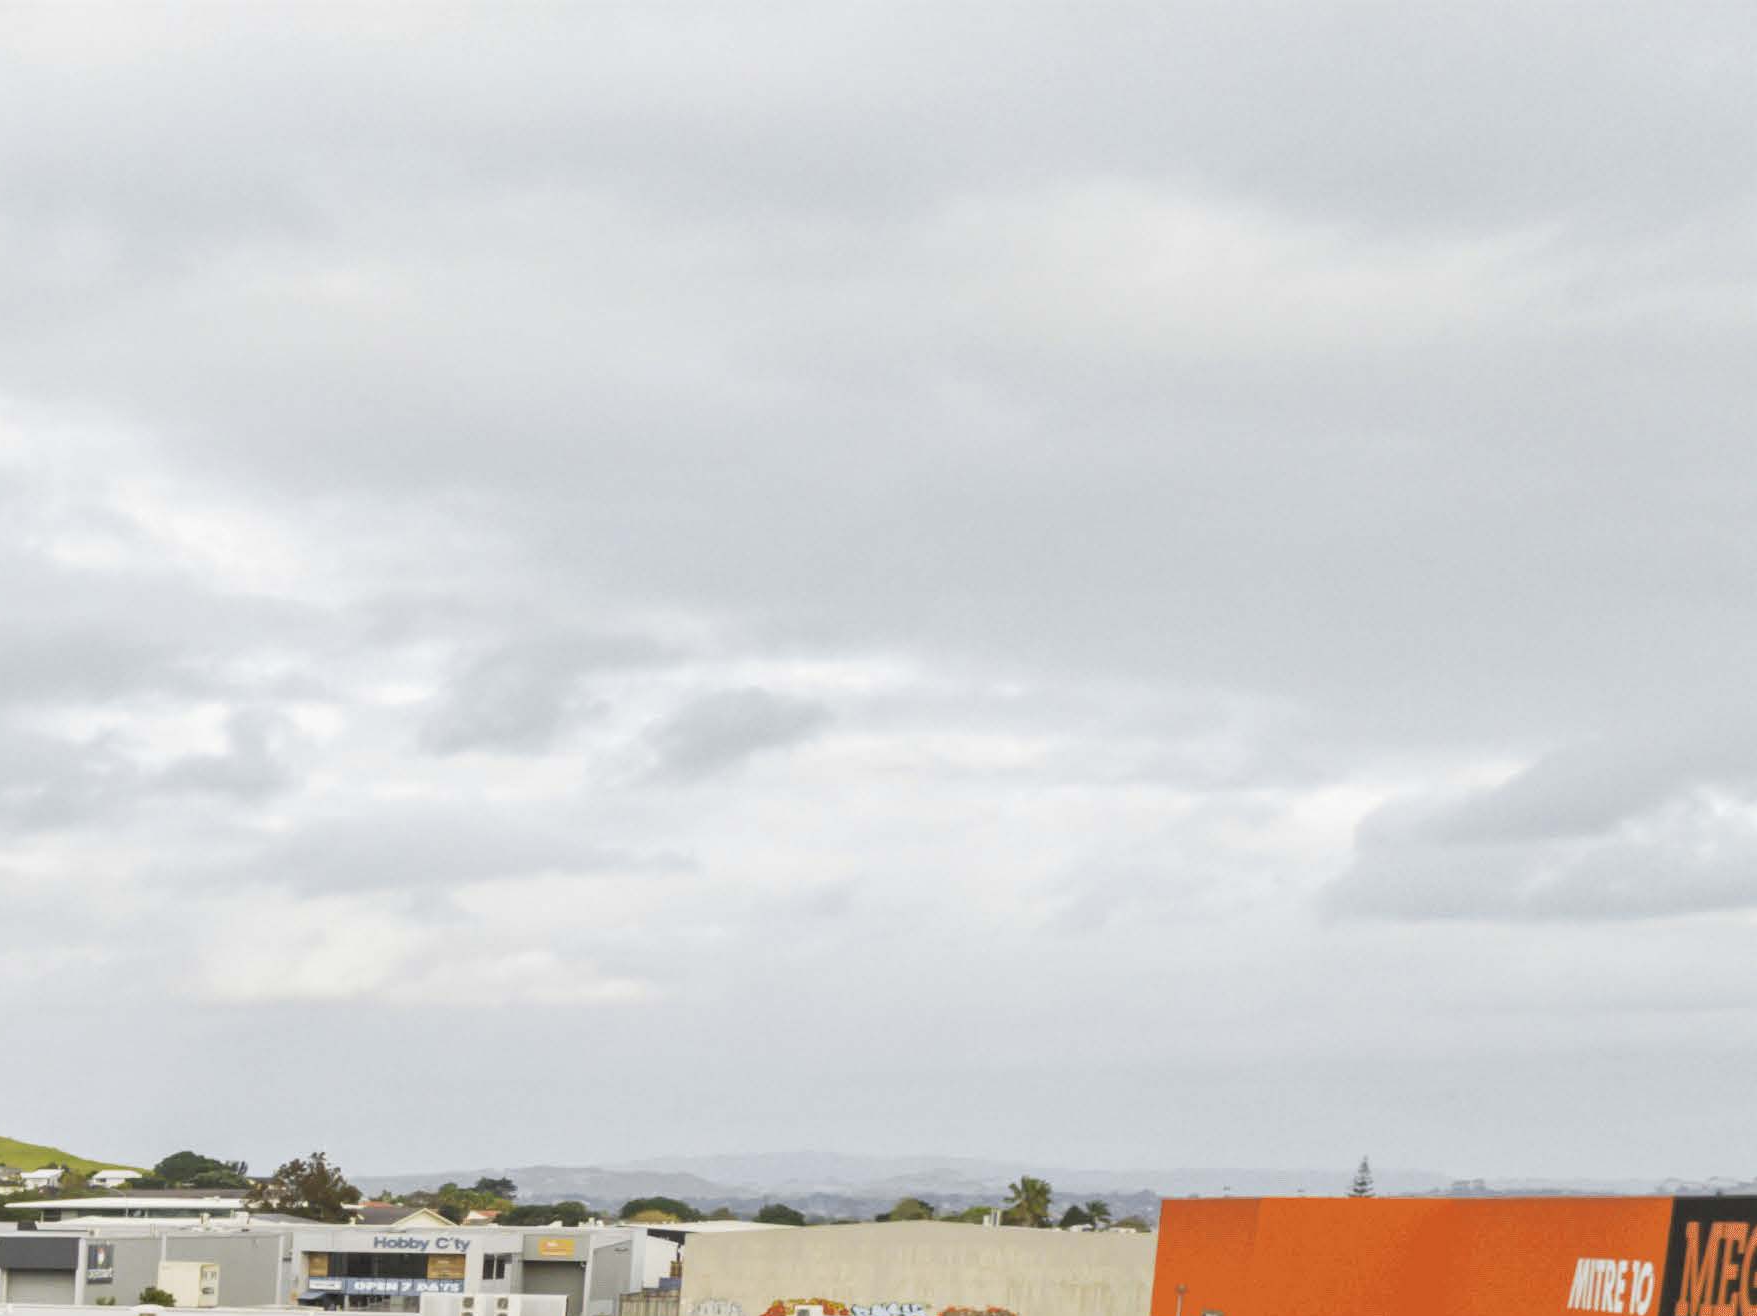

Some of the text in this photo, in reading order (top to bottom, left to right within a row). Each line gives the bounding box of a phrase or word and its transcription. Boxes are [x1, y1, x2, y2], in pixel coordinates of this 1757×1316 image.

[373, 1236, 471, 1252] Hobby Cty
[354, 1281, 398, 1291] OPEN
[401, 1282, 412, 1291] 7
[1567, 1258, 1655, 1316] MITRE 10
